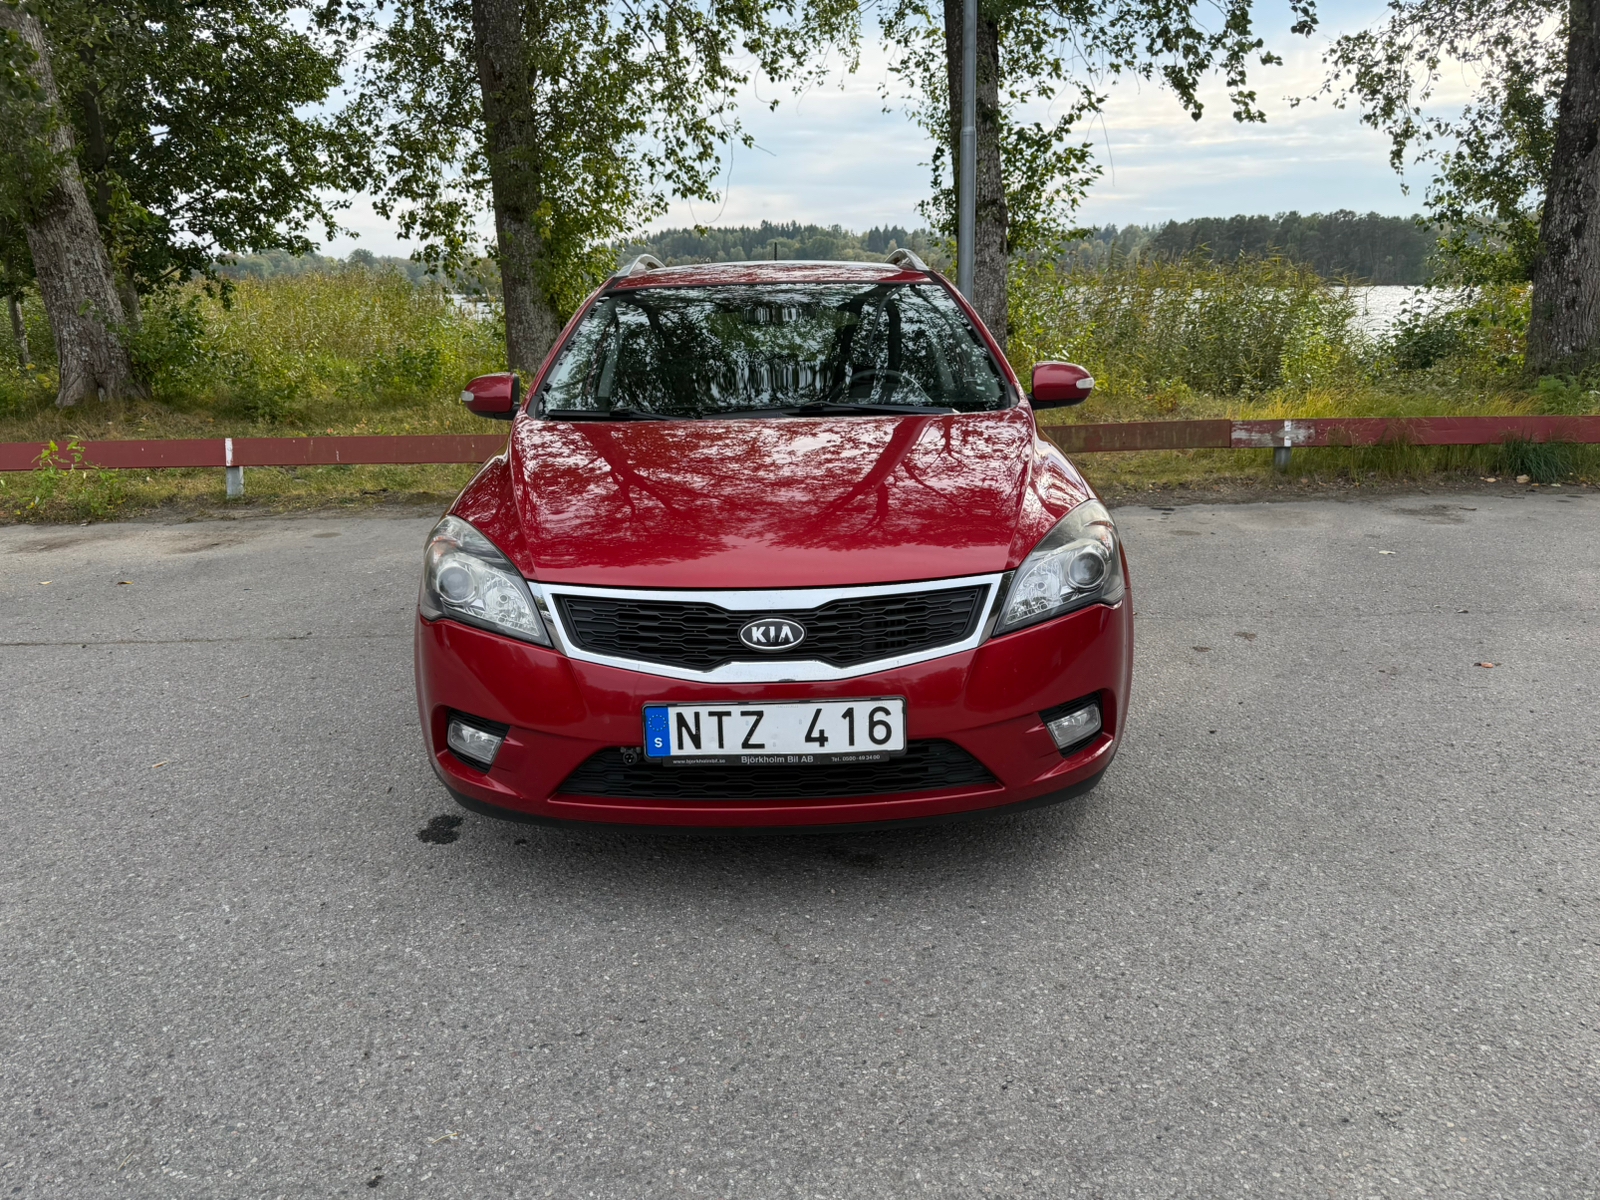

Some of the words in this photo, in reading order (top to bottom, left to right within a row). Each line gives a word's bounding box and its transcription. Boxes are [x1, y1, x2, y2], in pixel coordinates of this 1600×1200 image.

[751, 624, 794, 642] KIA
[676, 710, 766, 750] NTZ
[804, 706, 893, 747] 416
[654, 737, 663, 748] S
[741, 755, 785, 765] Björkholm
[787, 755, 799, 763] Bil
[801, 755, 814, 763] AB
